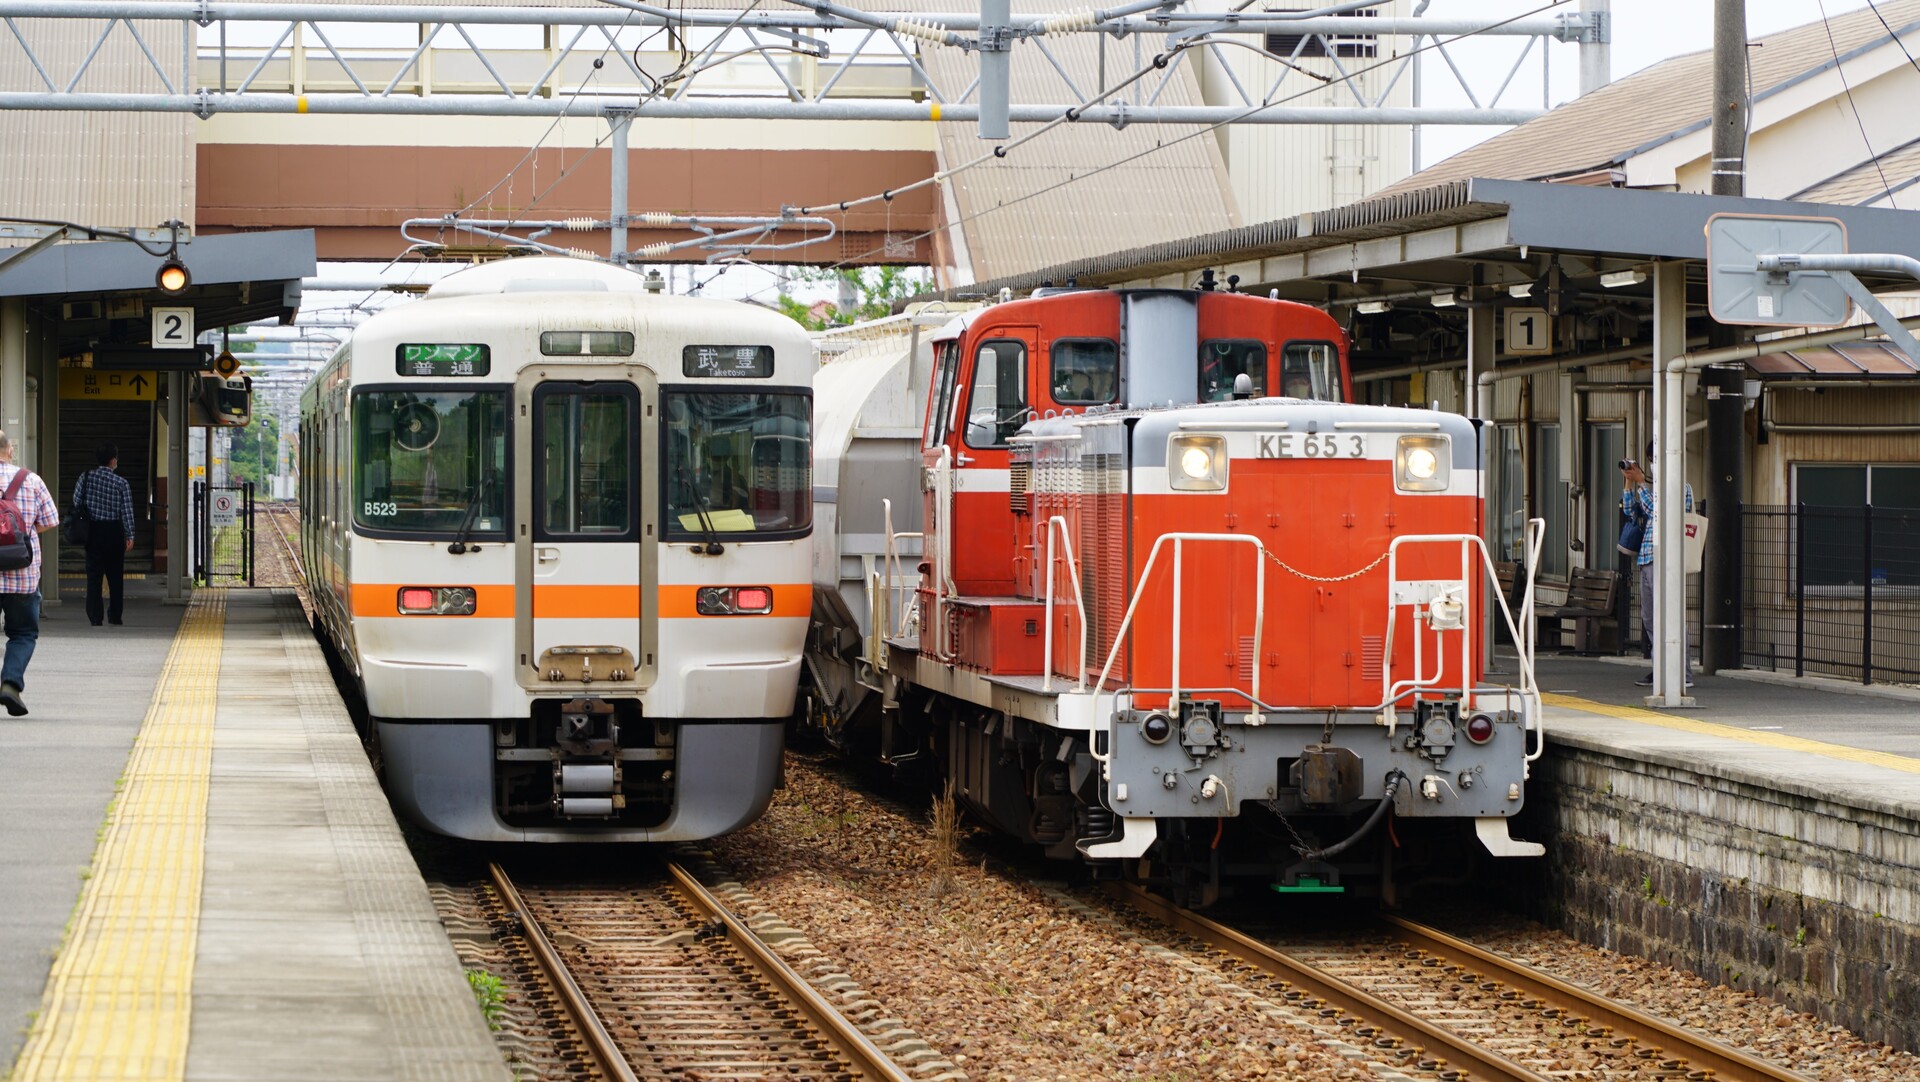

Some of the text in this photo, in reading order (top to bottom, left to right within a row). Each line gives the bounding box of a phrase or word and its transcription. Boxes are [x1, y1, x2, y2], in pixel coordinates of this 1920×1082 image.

[164, 315, 182, 339] 2
[1519, 316, 1533, 345] 1
[406, 345, 480, 360] ワンマン
[698, 348, 755, 369] 武豊
[412, 361, 474, 375] 普通
[708, 368, 746, 377] Taketoyo
[84, 374, 121, 386] 出口
[84, 387, 101, 395] Exit
[1260, 435, 1293, 458] KE
[364, 501, 397, 516] B523
